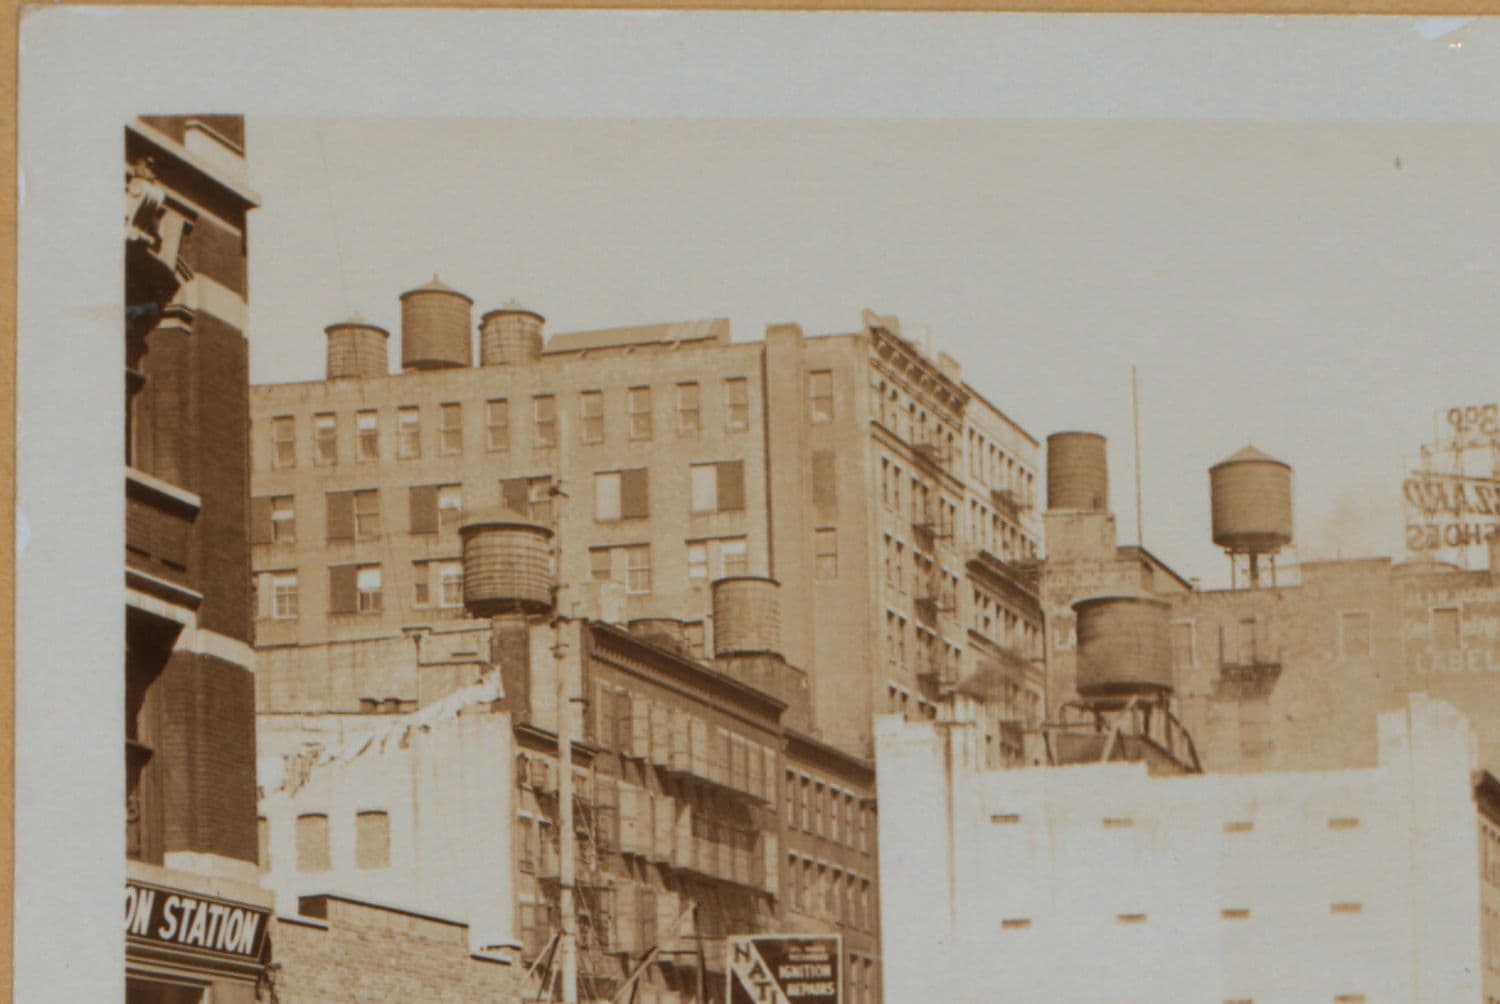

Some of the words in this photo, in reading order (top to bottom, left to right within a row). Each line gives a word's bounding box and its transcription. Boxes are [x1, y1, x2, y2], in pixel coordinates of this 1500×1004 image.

[158, 895, 260, 955] STATION
[779, 965, 833, 980] IGNITION
[786, 981, 836, 996] REPAIRS
